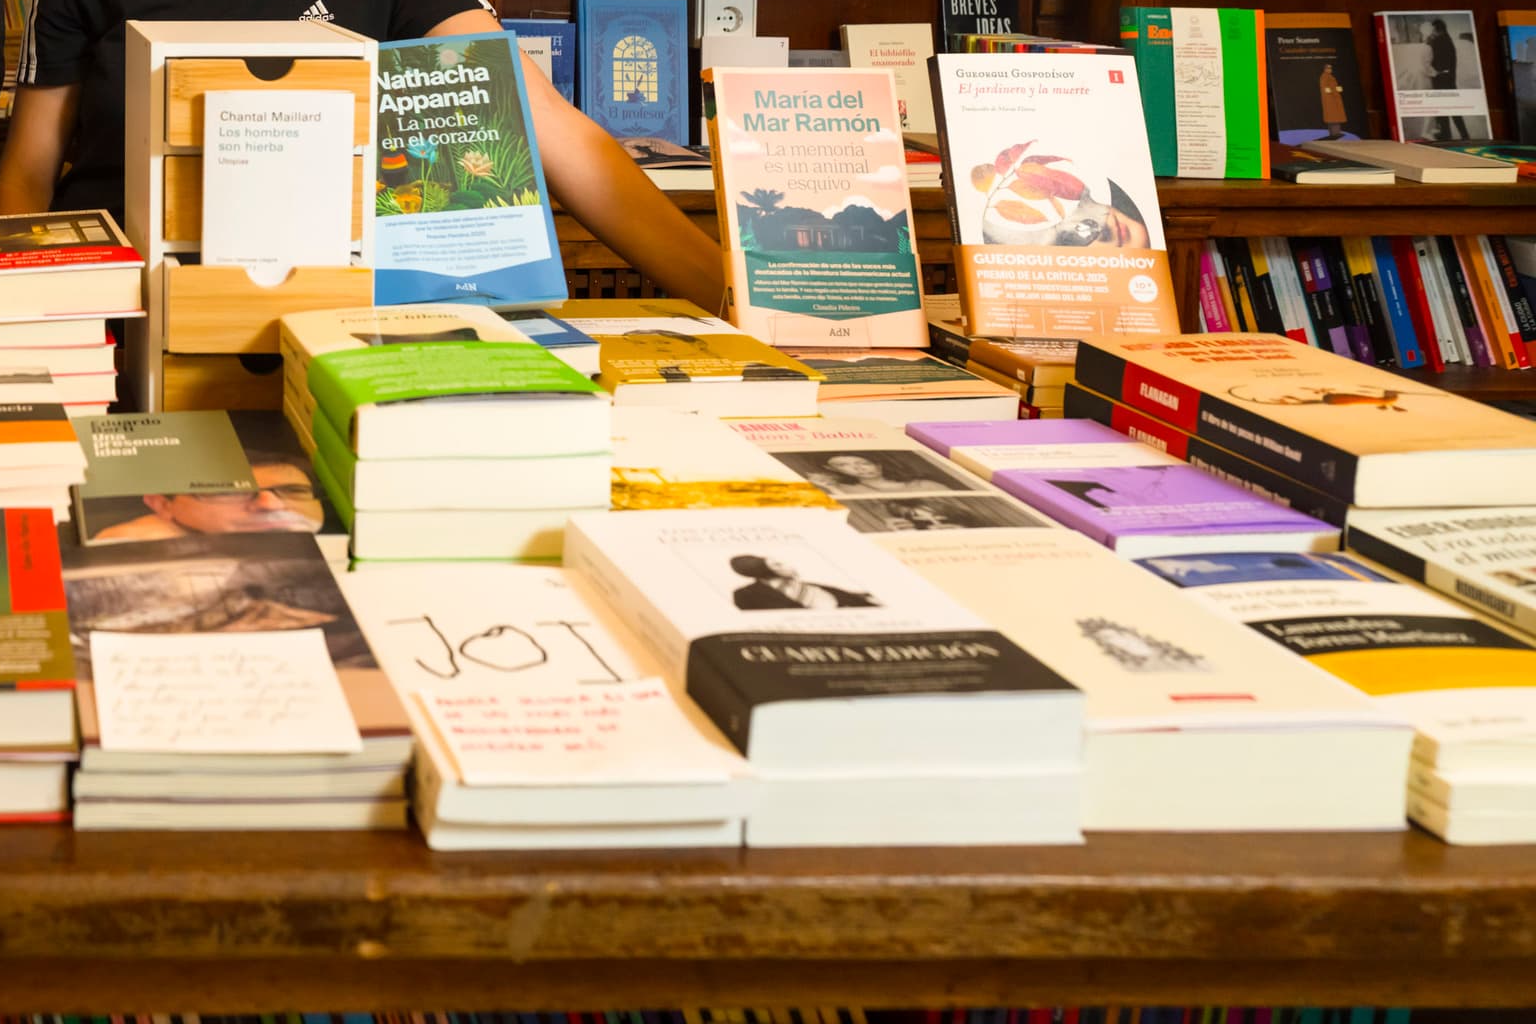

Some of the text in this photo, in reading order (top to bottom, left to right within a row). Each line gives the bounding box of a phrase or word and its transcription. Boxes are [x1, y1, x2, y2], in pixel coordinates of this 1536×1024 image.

[298, 13, 335, 23] adidas
[975, 17, 1012, 35] IDEAS
[376, 64, 490, 91] Nathacha
[753, 89, 864, 110] María del
[958, 82, 1092, 100] El jardinero y la muerte
[378, 85, 490, 116] Appanah
[219, 110, 322, 123] Chantal Maillard
[396, 113, 479, 131] La noche
[743, 111, 881, 133] Mar Ramón
[218, 127, 300, 139] Los hombres
[381, 126, 500, 149] en el corazón
[218, 140, 284, 153] son hierba
[765, 142, 865, 157] La memoria
[764, 158, 870, 174] es un animal
[786, 176, 851, 193] esquivo
[973, 252, 1156, 270] GUEORGUI GOSPODÍNOV
[975, 269, 1016, 280] PREMIO
[1017, 270, 1030, 281] DE
[1031, 270, 1045, 281] LA
[1046, 270, 1085, 282] CRÍTICA
[828, 327, 851, 337] AdN
[1139, 382, 1180, 412] FLANAGAN
[91, 432, 127, 442] Una
[93, 436, 181, 449] presencia
[740, 639, 1002, 665] CUARTA EDICIÓN
